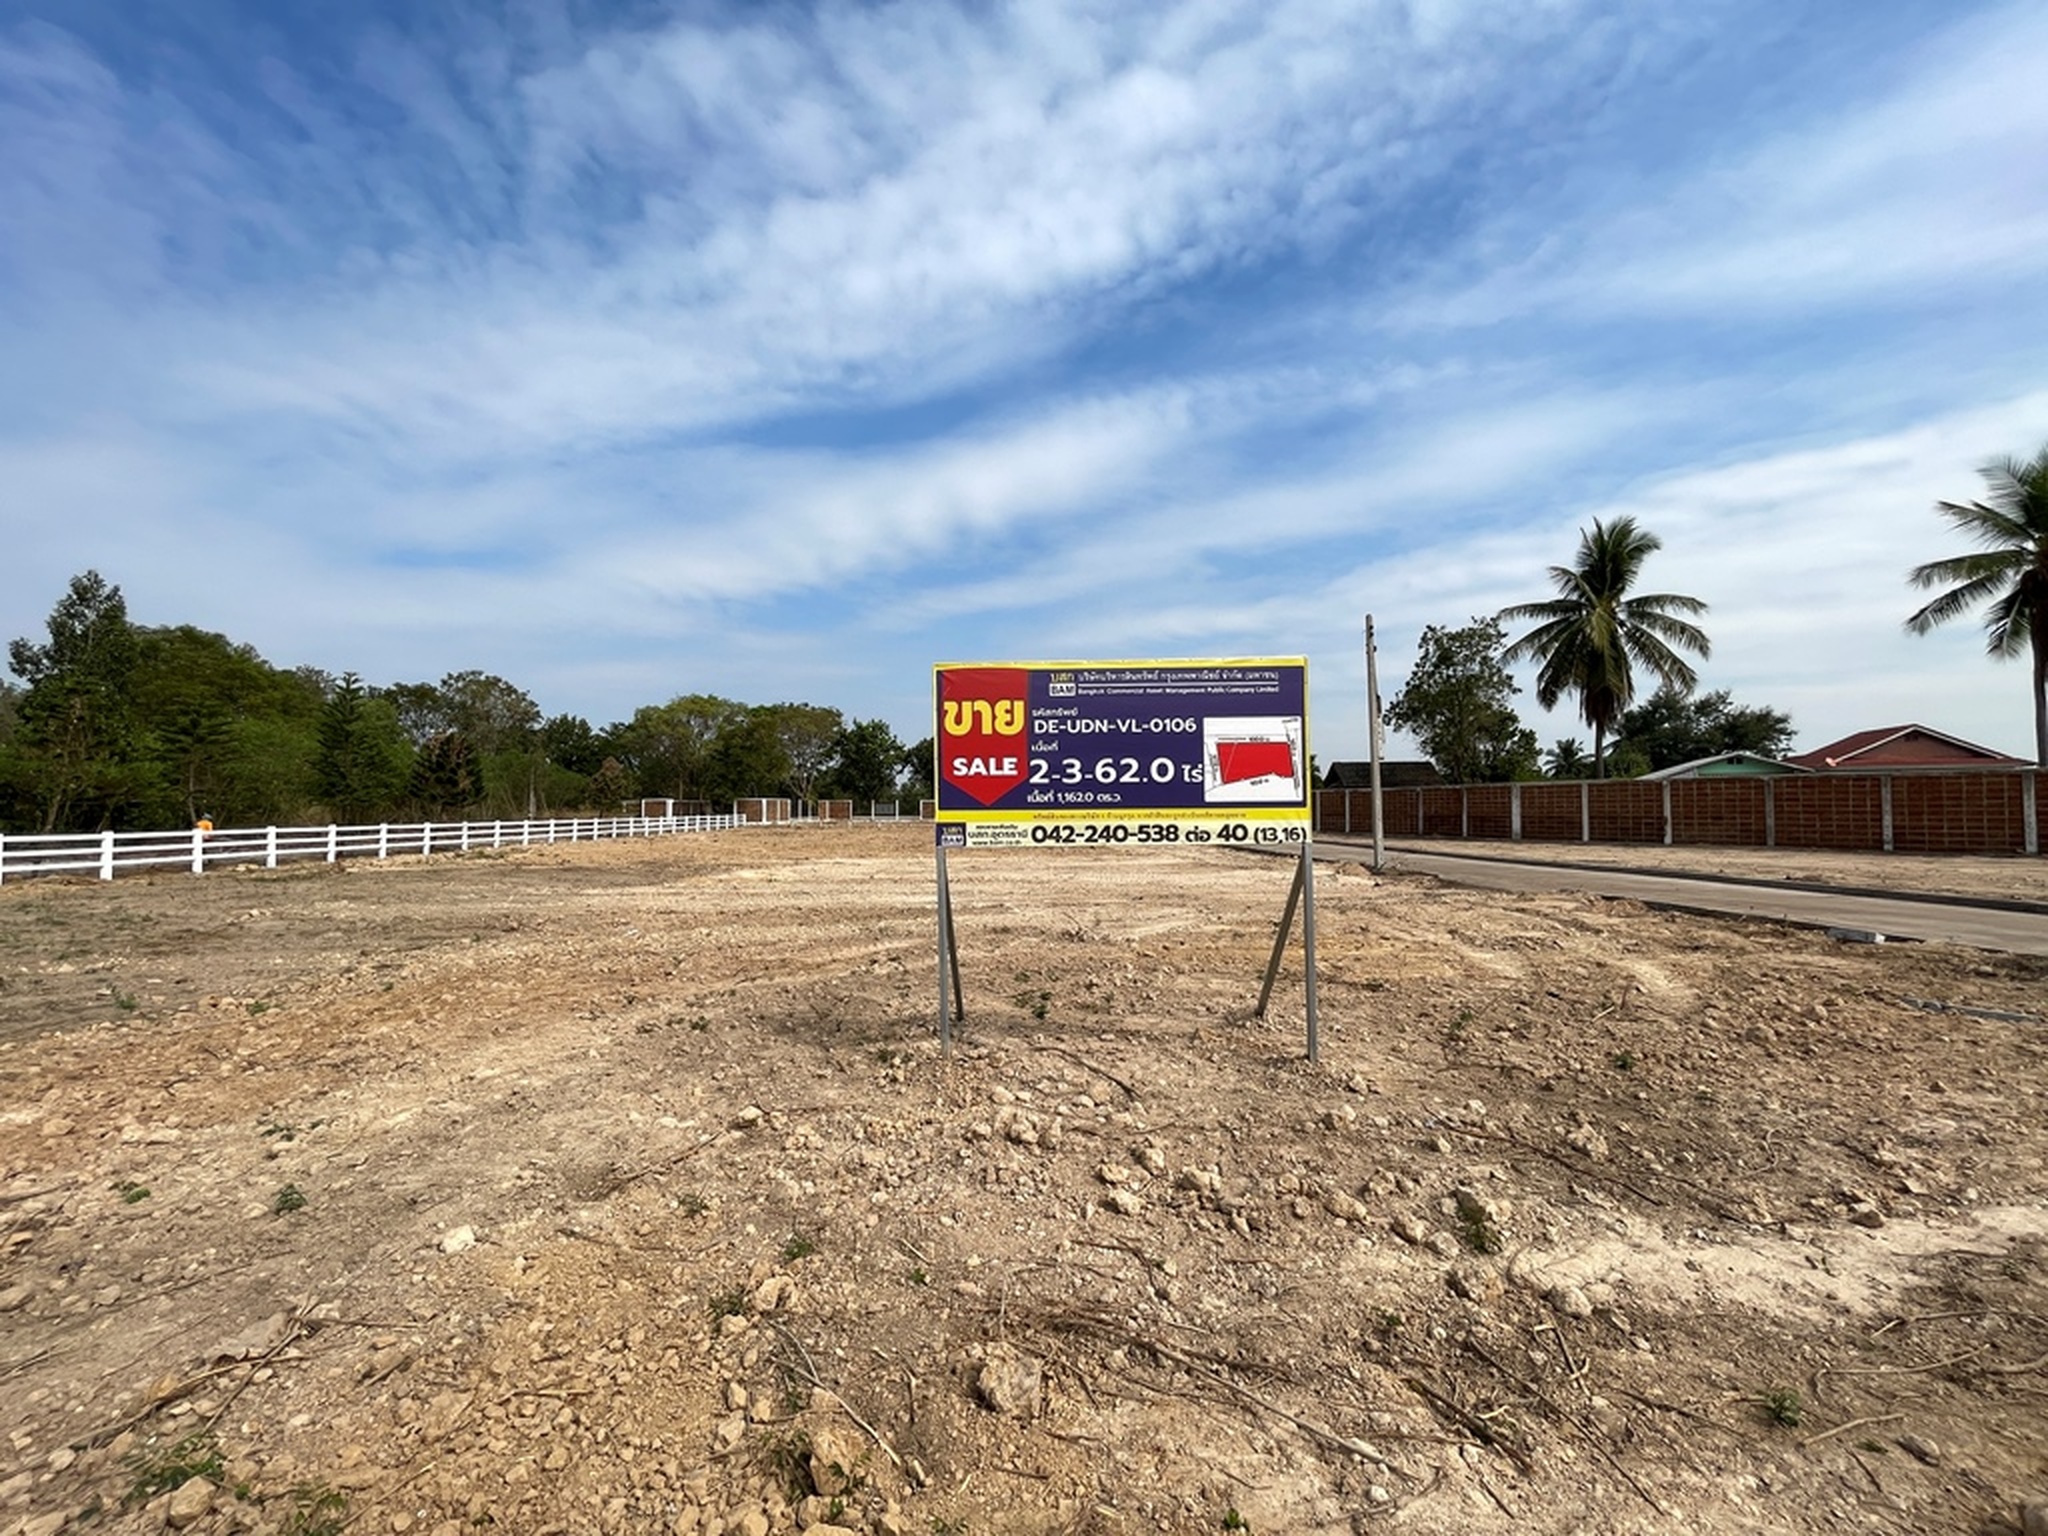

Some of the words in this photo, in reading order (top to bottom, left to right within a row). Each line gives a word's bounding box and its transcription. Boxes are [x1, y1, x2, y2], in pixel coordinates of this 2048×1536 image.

[1051, 685, 1075, 695] BAM
[1078, 687, 1105, 696] Bangkok
[1165, 687, 1206, 695] Management
[1225, 686, 1255, 694] Company
[1255, 685, 1280, 693] Limited
[943, 699, 1025, 736] ขาย
[1034, 717, 1197, 734] DE-UDN-VL-0106
[952, 756, 1018, 776] SALE
[1029, 757, 1176, 784] 2-3-62.0
[1181, 763, 1204, 783] ไร่
[1031, 824, 1179, 843] 042-240-538
[1185, 825, 1211, 842] ต่อ
[1217, 824, 1249, 842] 40
[1253, 826, 1307, 844] (13,16)
